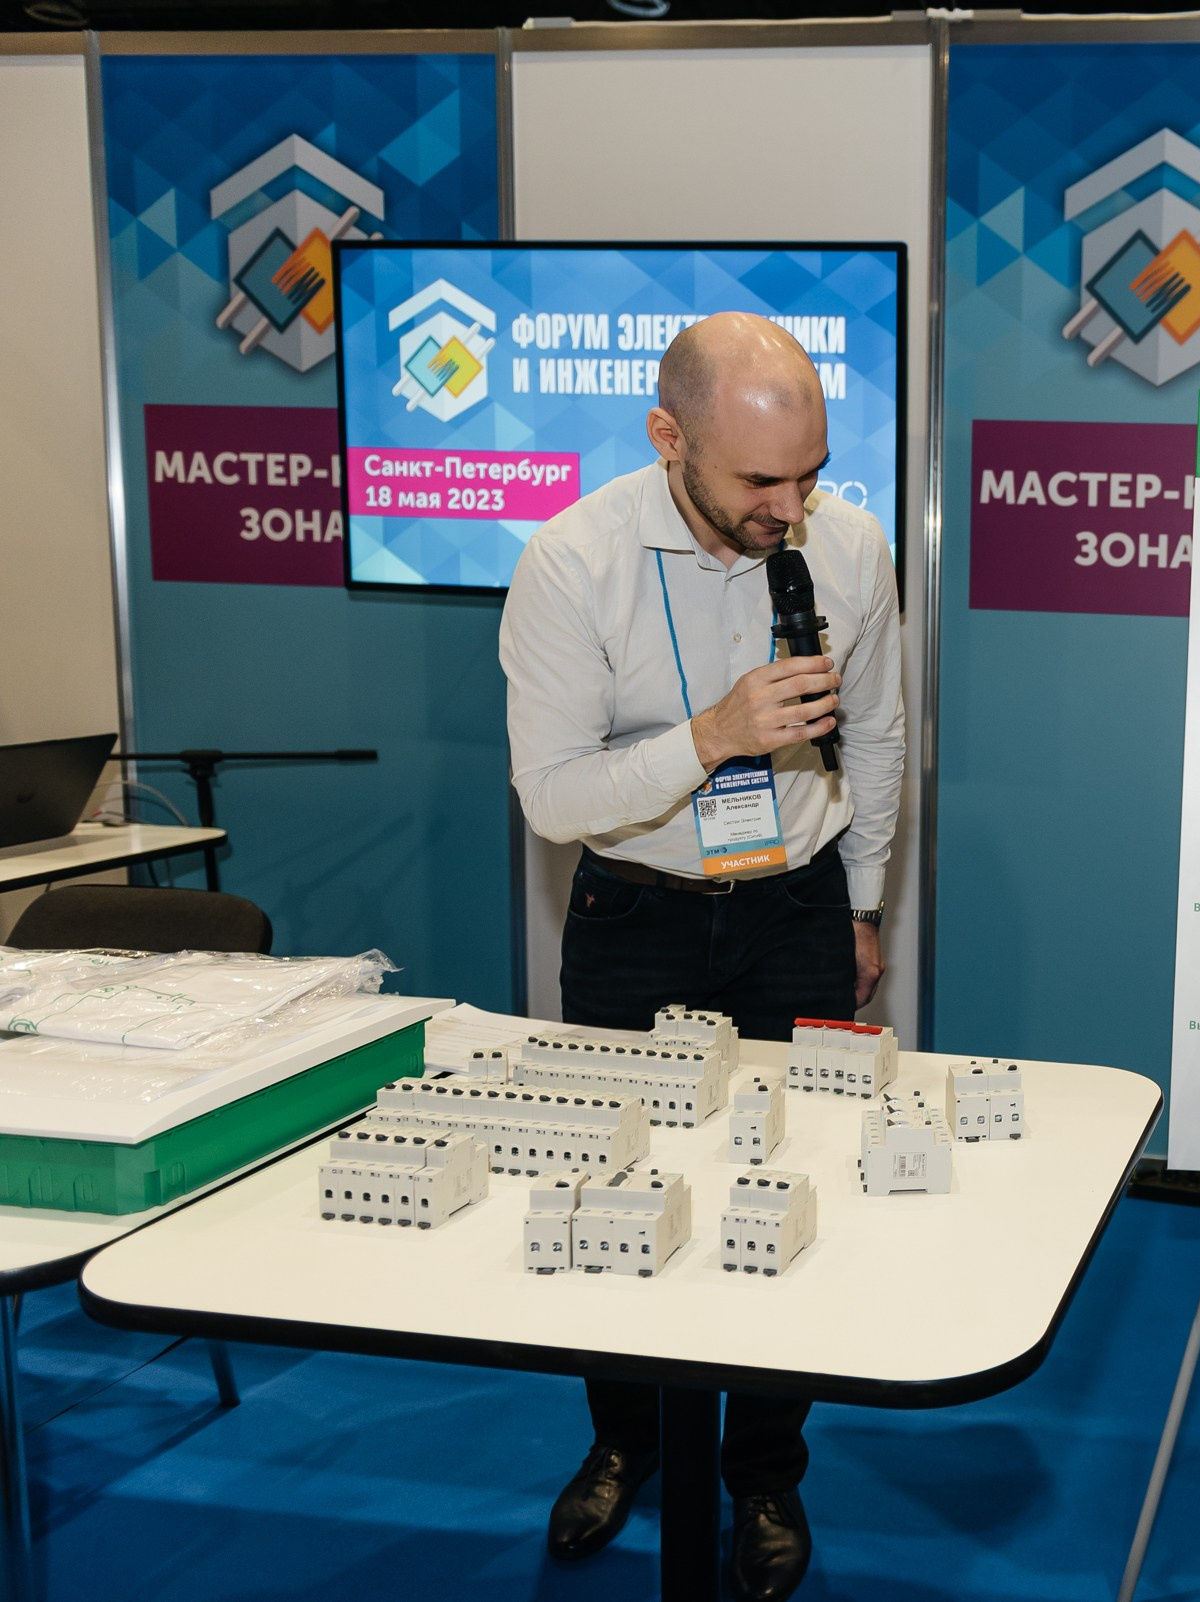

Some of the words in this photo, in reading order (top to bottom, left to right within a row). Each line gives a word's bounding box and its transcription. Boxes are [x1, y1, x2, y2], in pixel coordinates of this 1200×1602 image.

[512, 313, 609, 350] ФОРУМ
[513, 358, 529, 394] И
[540, 358, 660, 396] ИНЖЕНЕР
[364, 454, 572, 486] Санкт-Петербург
[366, 486, 391, 507] 18
[398, 491, 441, 508] мая
[447, 488, 505, 510] 2023
[240, 507, 343, 543] ЗОНА
[1074, 531, 1193, 568] ЗОНА
[722, 794, 761, 804] МЕЛЬНИКОВ
[726, 802, 759, 811] Александр
[721, 854, 770, 869] УЧАСТНИК
